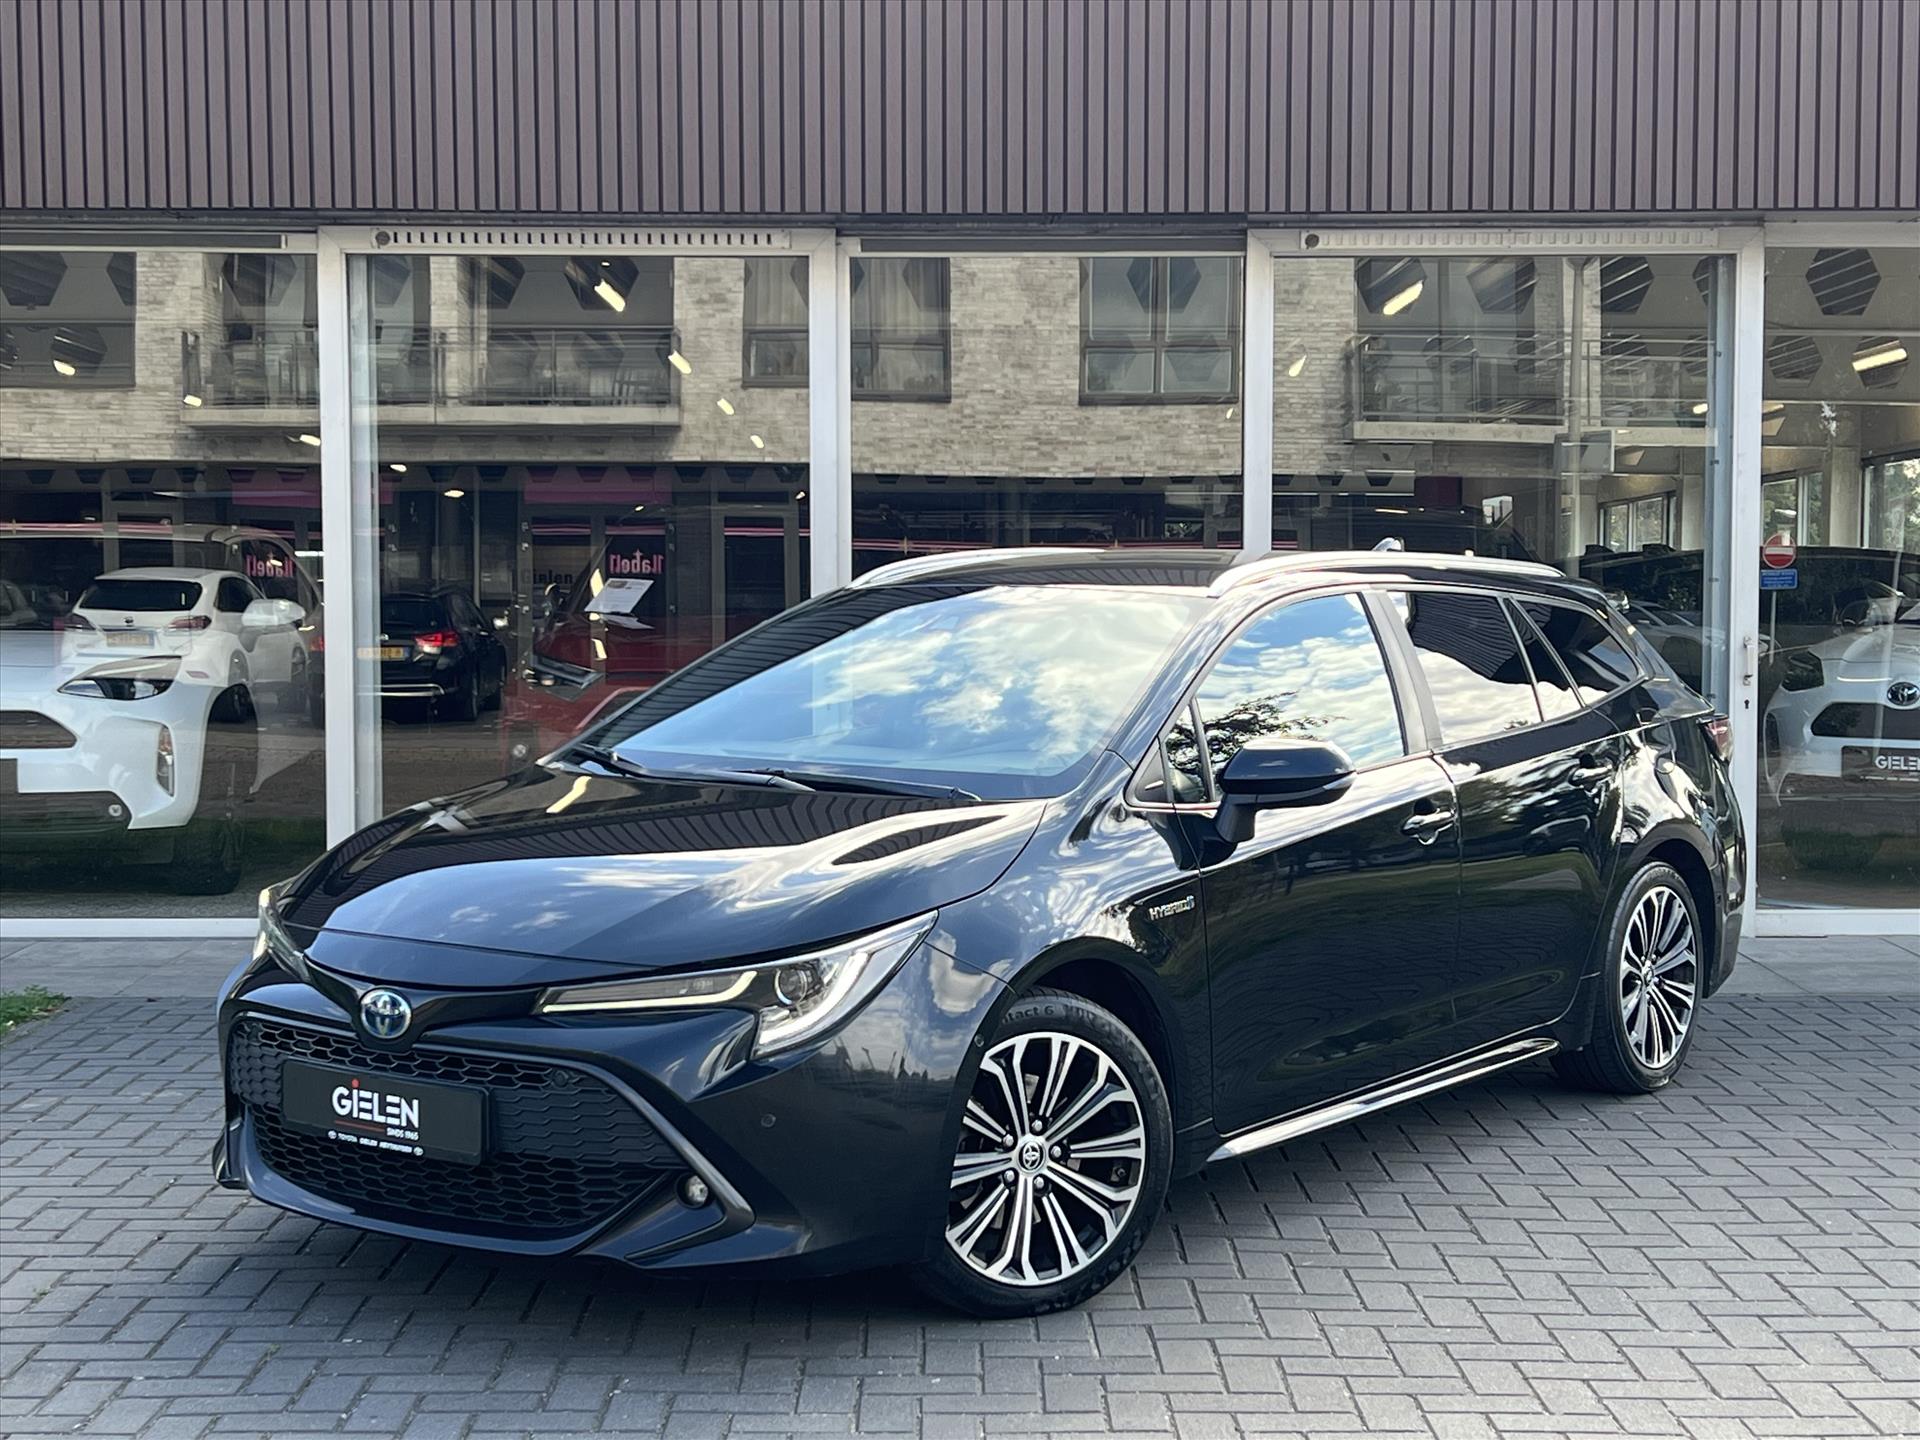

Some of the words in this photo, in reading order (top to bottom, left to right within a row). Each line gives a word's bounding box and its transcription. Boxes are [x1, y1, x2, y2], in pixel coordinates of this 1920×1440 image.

[1149, 899, 1188, 921] HYBRID
[1044, 1005, 1055, 1016] 6
[332, 1079, 419, 1128] GIELEN
